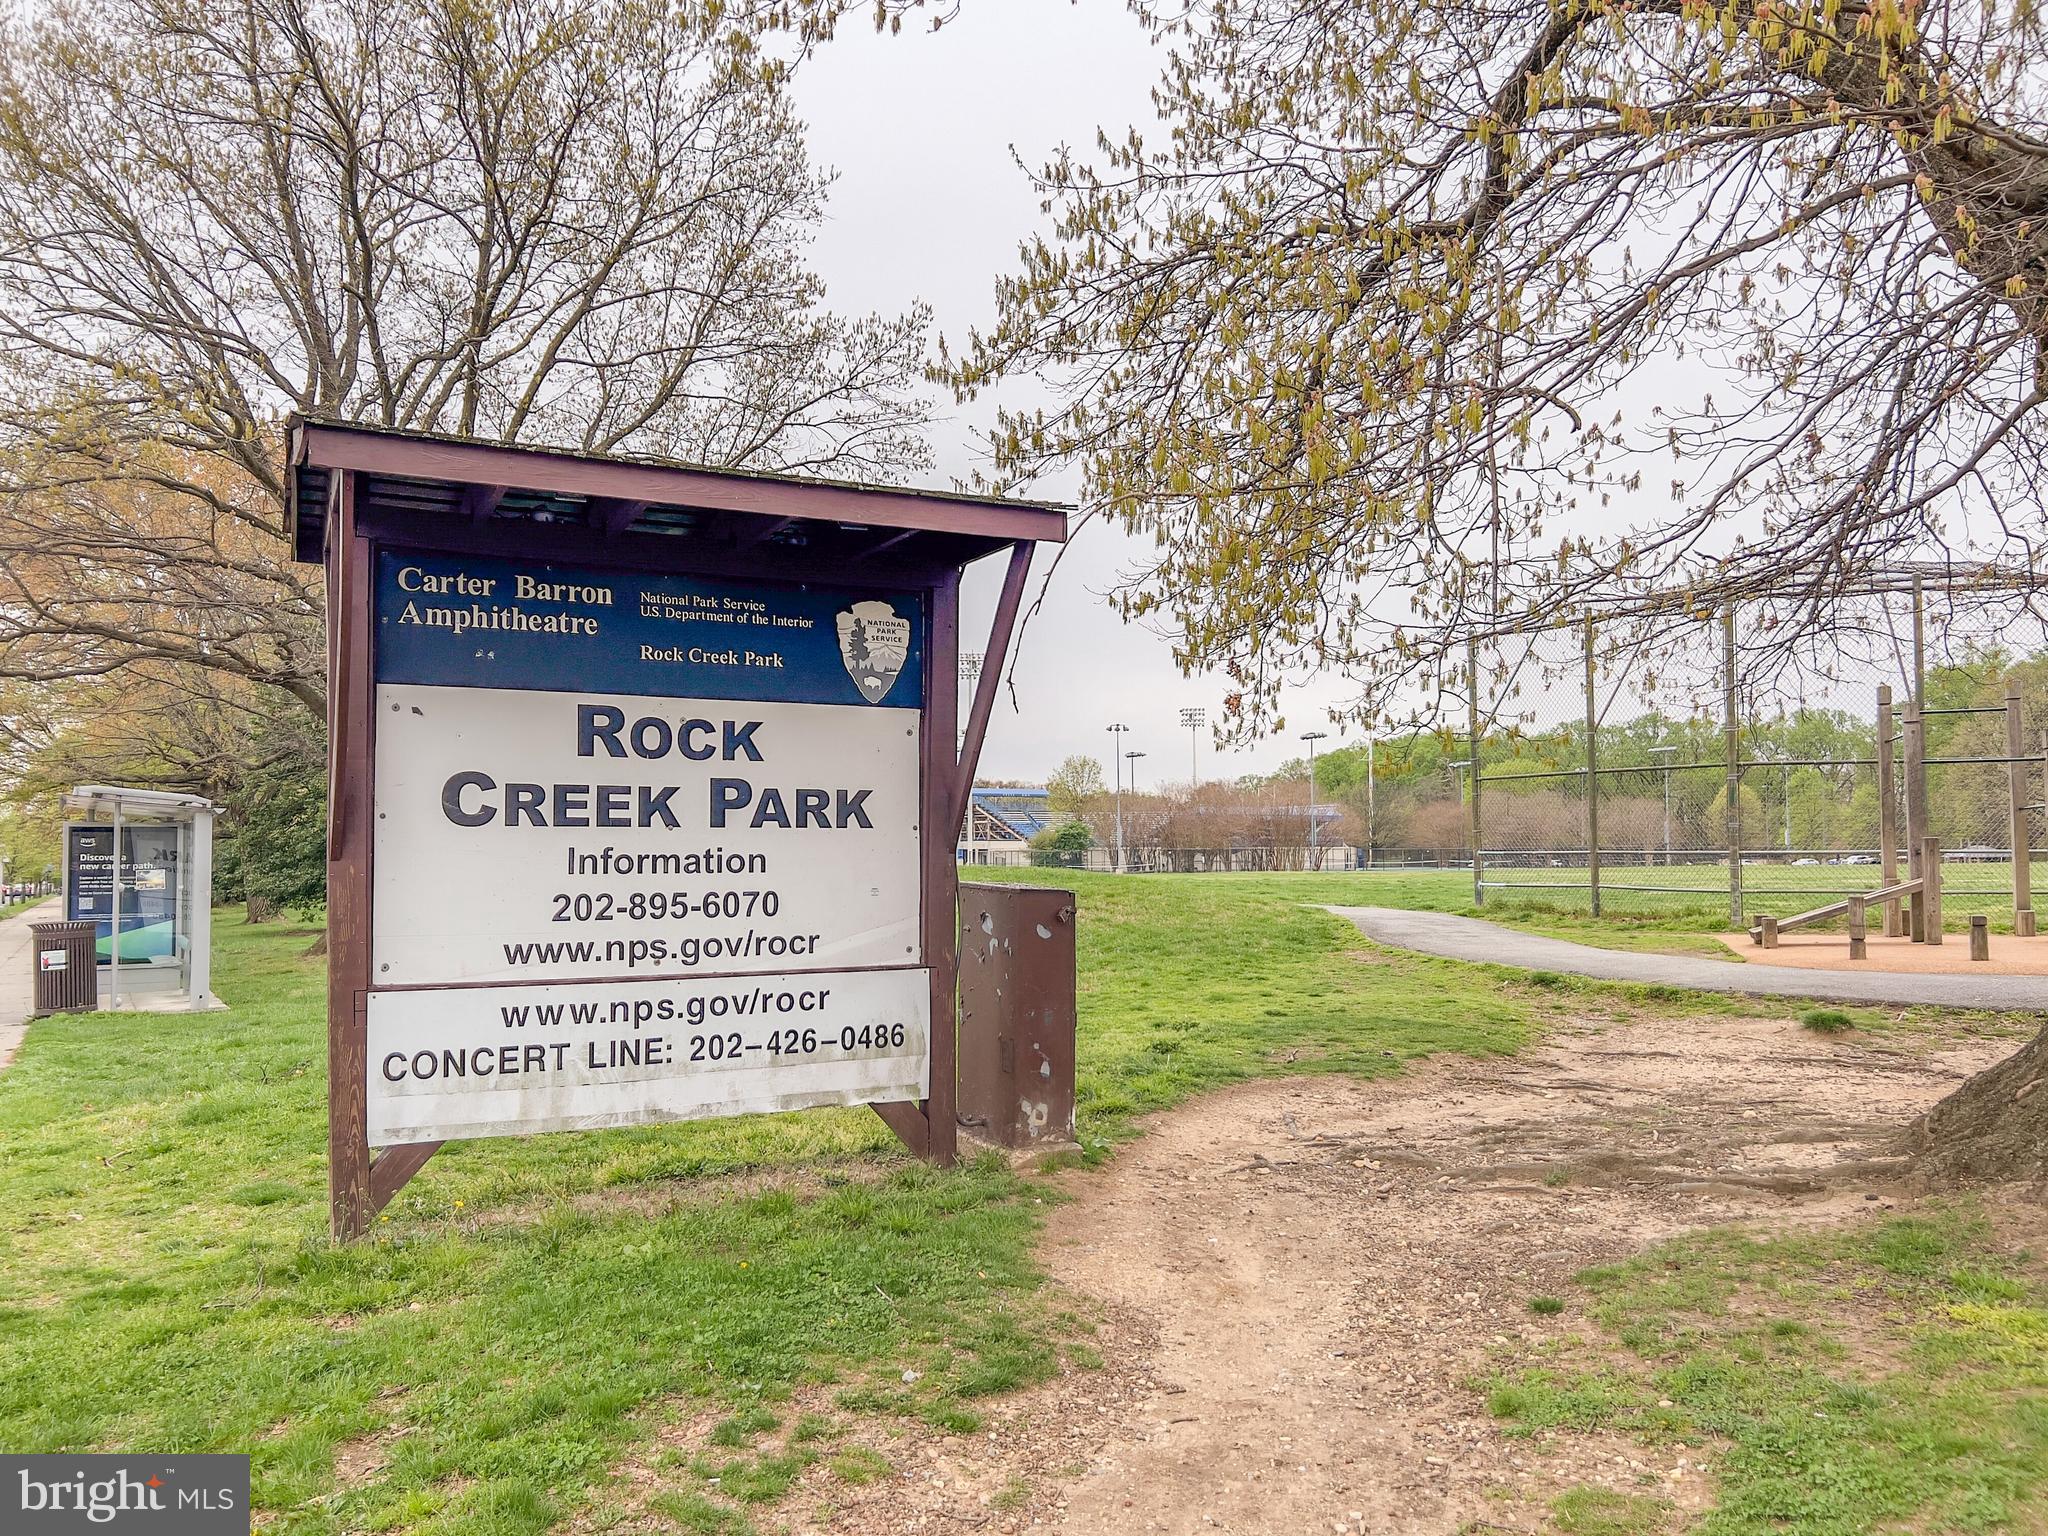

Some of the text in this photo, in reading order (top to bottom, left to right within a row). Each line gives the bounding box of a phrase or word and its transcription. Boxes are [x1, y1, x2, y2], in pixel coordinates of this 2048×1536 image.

[397, 566, 613, 605] Carter Barron
[639, 591, 766, 612] National Park Service
[640, 605, 814, 629] U.S. Department of the Interior
[397, 600, 599, 635] Amphitheatre
[867, 619, 906, 628] NATIONAL
[871, 635, 903, 643] SERVICE
[639, 644, 784, 668] Rock Creek Park
[577, 703, 765, 763] ROCK
[441, 770, 874, 829] CREEK PARK
[79, 853, 114, 862] Discove
[132, 861, 156, 871] path.
[567, 846, 767, 876] Information
[551, 890, 780, 923] 202-895-6070
[503, 929, 821, 969] www.nps.gov/rocr
[500, 986, 831, 1030] www.nps.gov/rocr
[382, 1021, 906, 1083] CONCERT LINE: 202-426-0486
